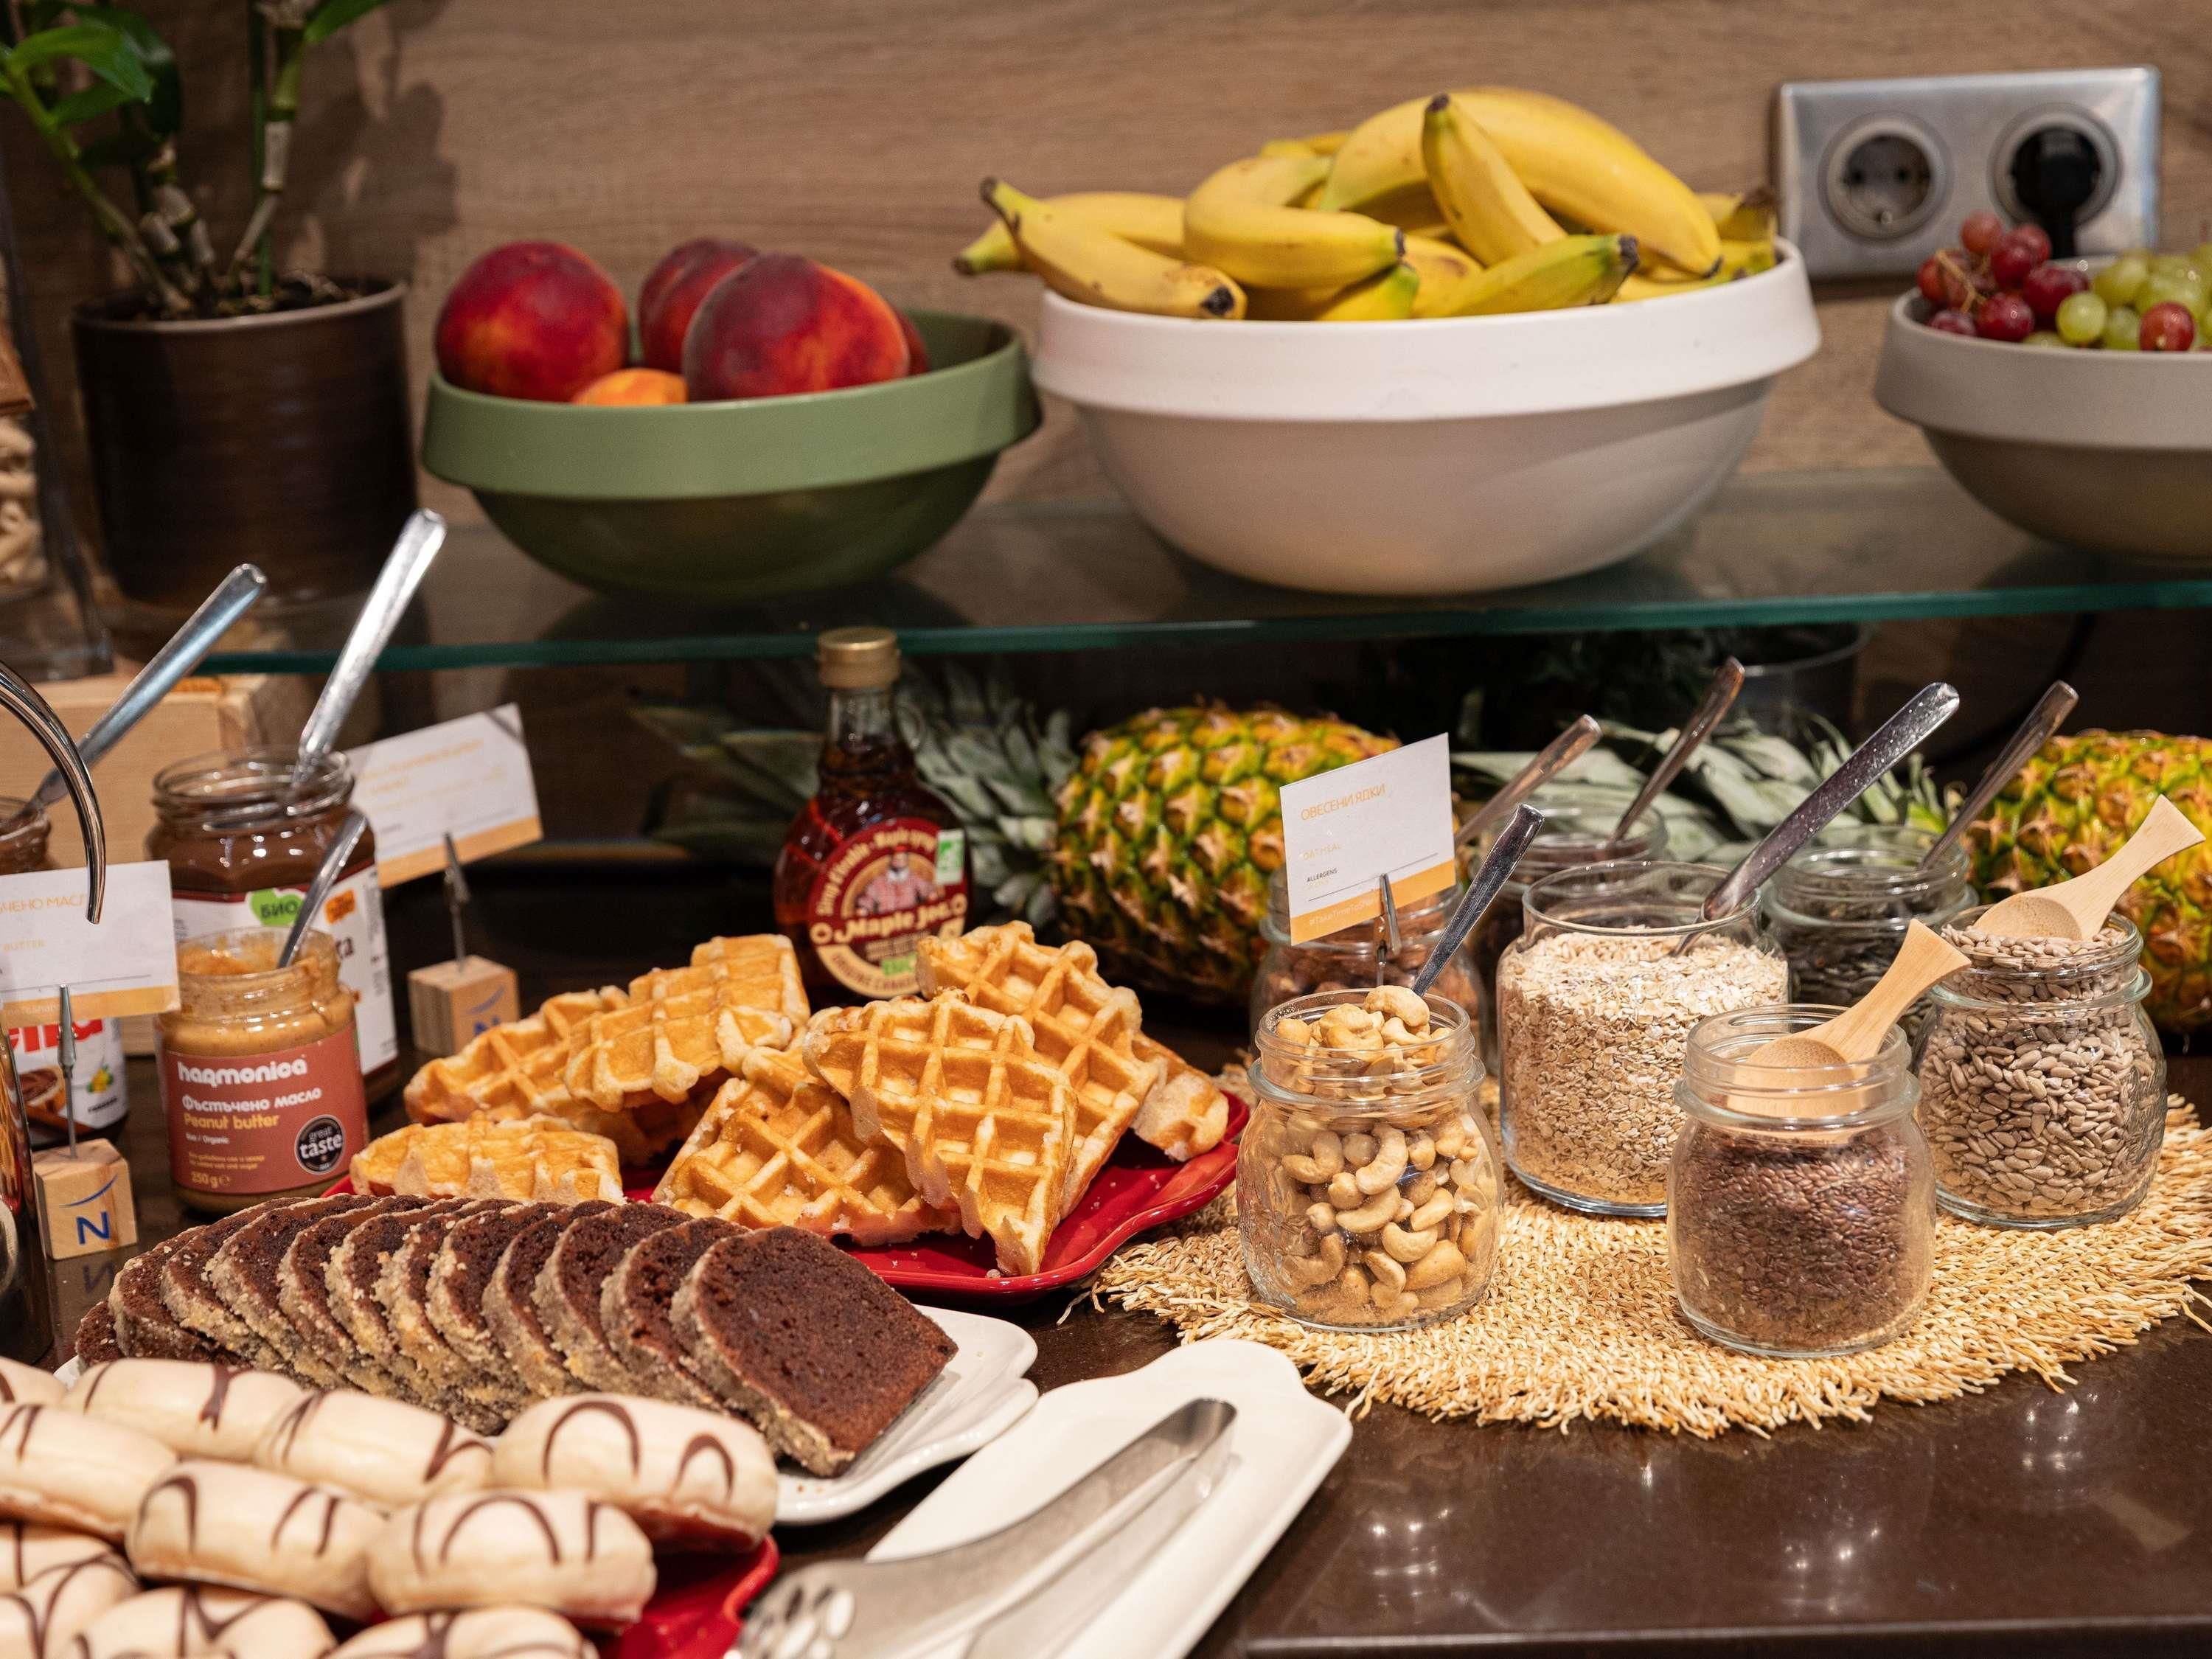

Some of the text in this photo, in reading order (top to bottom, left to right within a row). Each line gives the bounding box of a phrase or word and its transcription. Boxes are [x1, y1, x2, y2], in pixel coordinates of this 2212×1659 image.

[1301, 783, 1386, 821] ОВЕСЕНИ ЯДКИ
[1307, 867, 1338, 883] ALLERGENS
[260, 899, 301, 919] БИО
[182, 1088, 322, 1113] Фъстъчено масло
[184, 1113, 279, 1130] Peanut butter
[299, 1134, 342, 1159] taste
[76, 1211, 111, 1245] N
